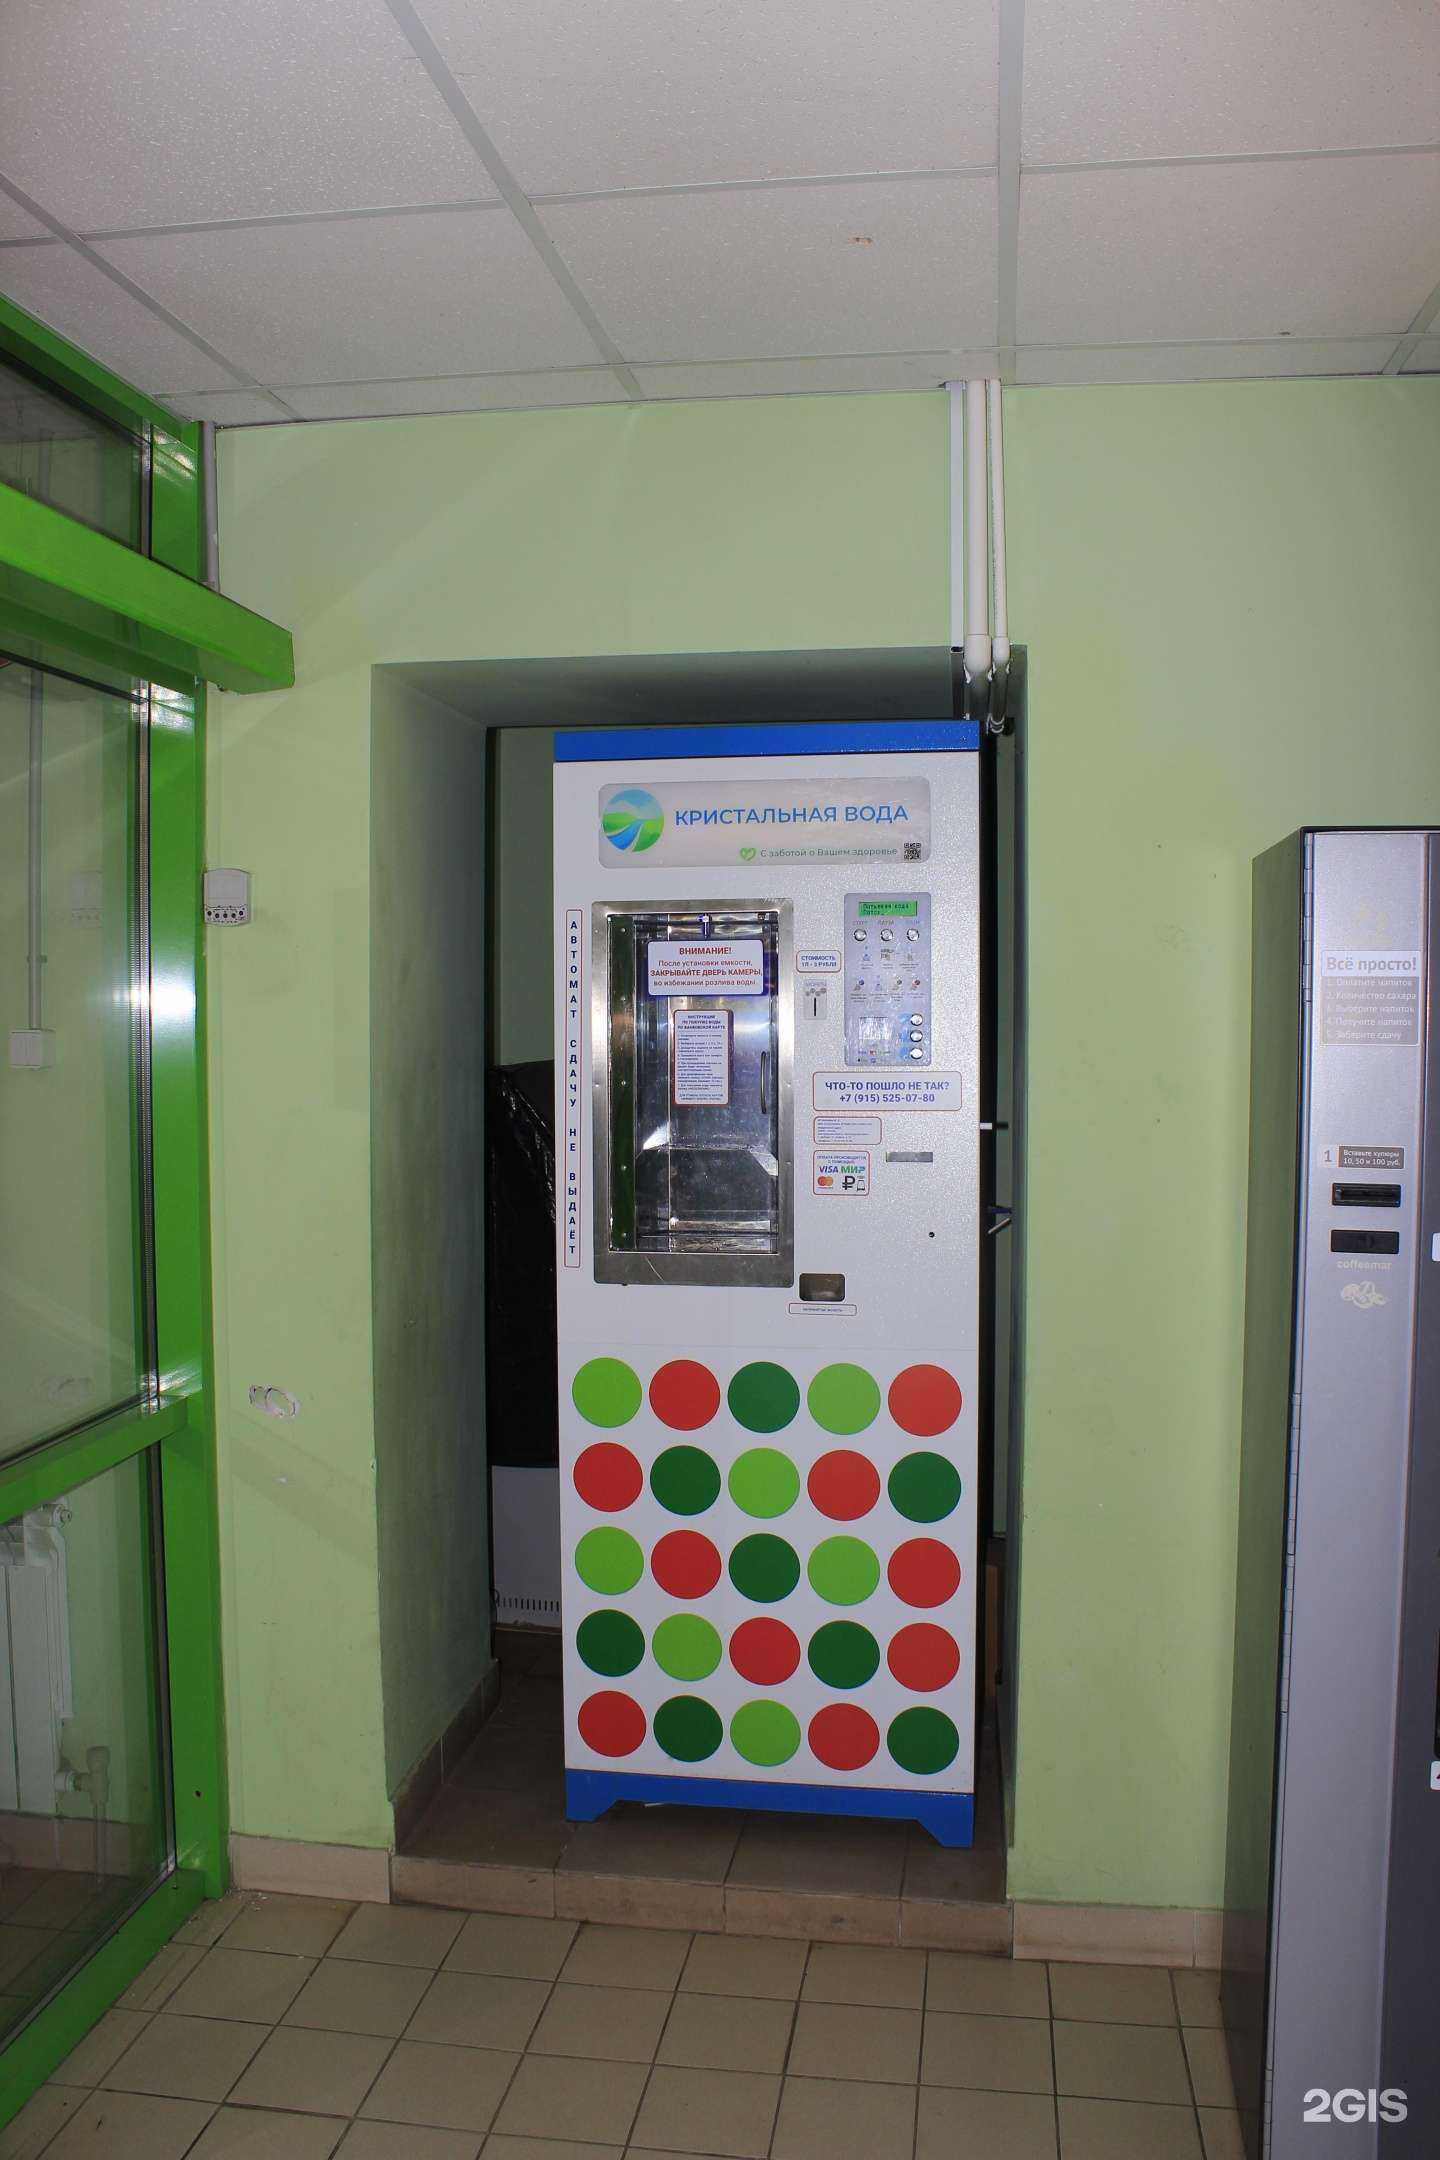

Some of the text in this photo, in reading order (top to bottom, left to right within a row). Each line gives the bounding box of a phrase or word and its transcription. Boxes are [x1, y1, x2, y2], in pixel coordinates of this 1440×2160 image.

[675, 805, 909, 825] КРИСТАЛЬНАЯ ВОДА
[760, 849, 767, 857] С
[768, 848, 807, 857] заботой
[679, 947, 732, 955] ВНИМАНИЕ!
[682, 960, 719, 968] установки
[1327, 956, 1417, 974] Всё просто!
[569, 920, 578, 1018] АВТОМАТ
[650, 968, 701, 977] ЗАКРЫВАЙТЕ
[728, 968, 763, 977] КАМЕРЫ,
[1387, 992, 1417, 1001] сахара
[568, 1040, 577, 1107] СДАЧУ
[825, 1082, 950, 1090] ЧТО-ТО ПОШЛО НЕ ТАК?
[840, 1093, 935, 1104] +7 (915) 525-07-80
[568, 1128, 577, 1151] НЕ
[1324, 1150, 1332, 1162] 1
[1343, 1149, 1371, 1157] Вставьте
[1343, 1158, 1353, 1166] 10,
[1387, 1159, 1401, 1168] руб.
[819, 1165, 839, 1173] VISA
[841, 1165, 866, 1174] МИР
